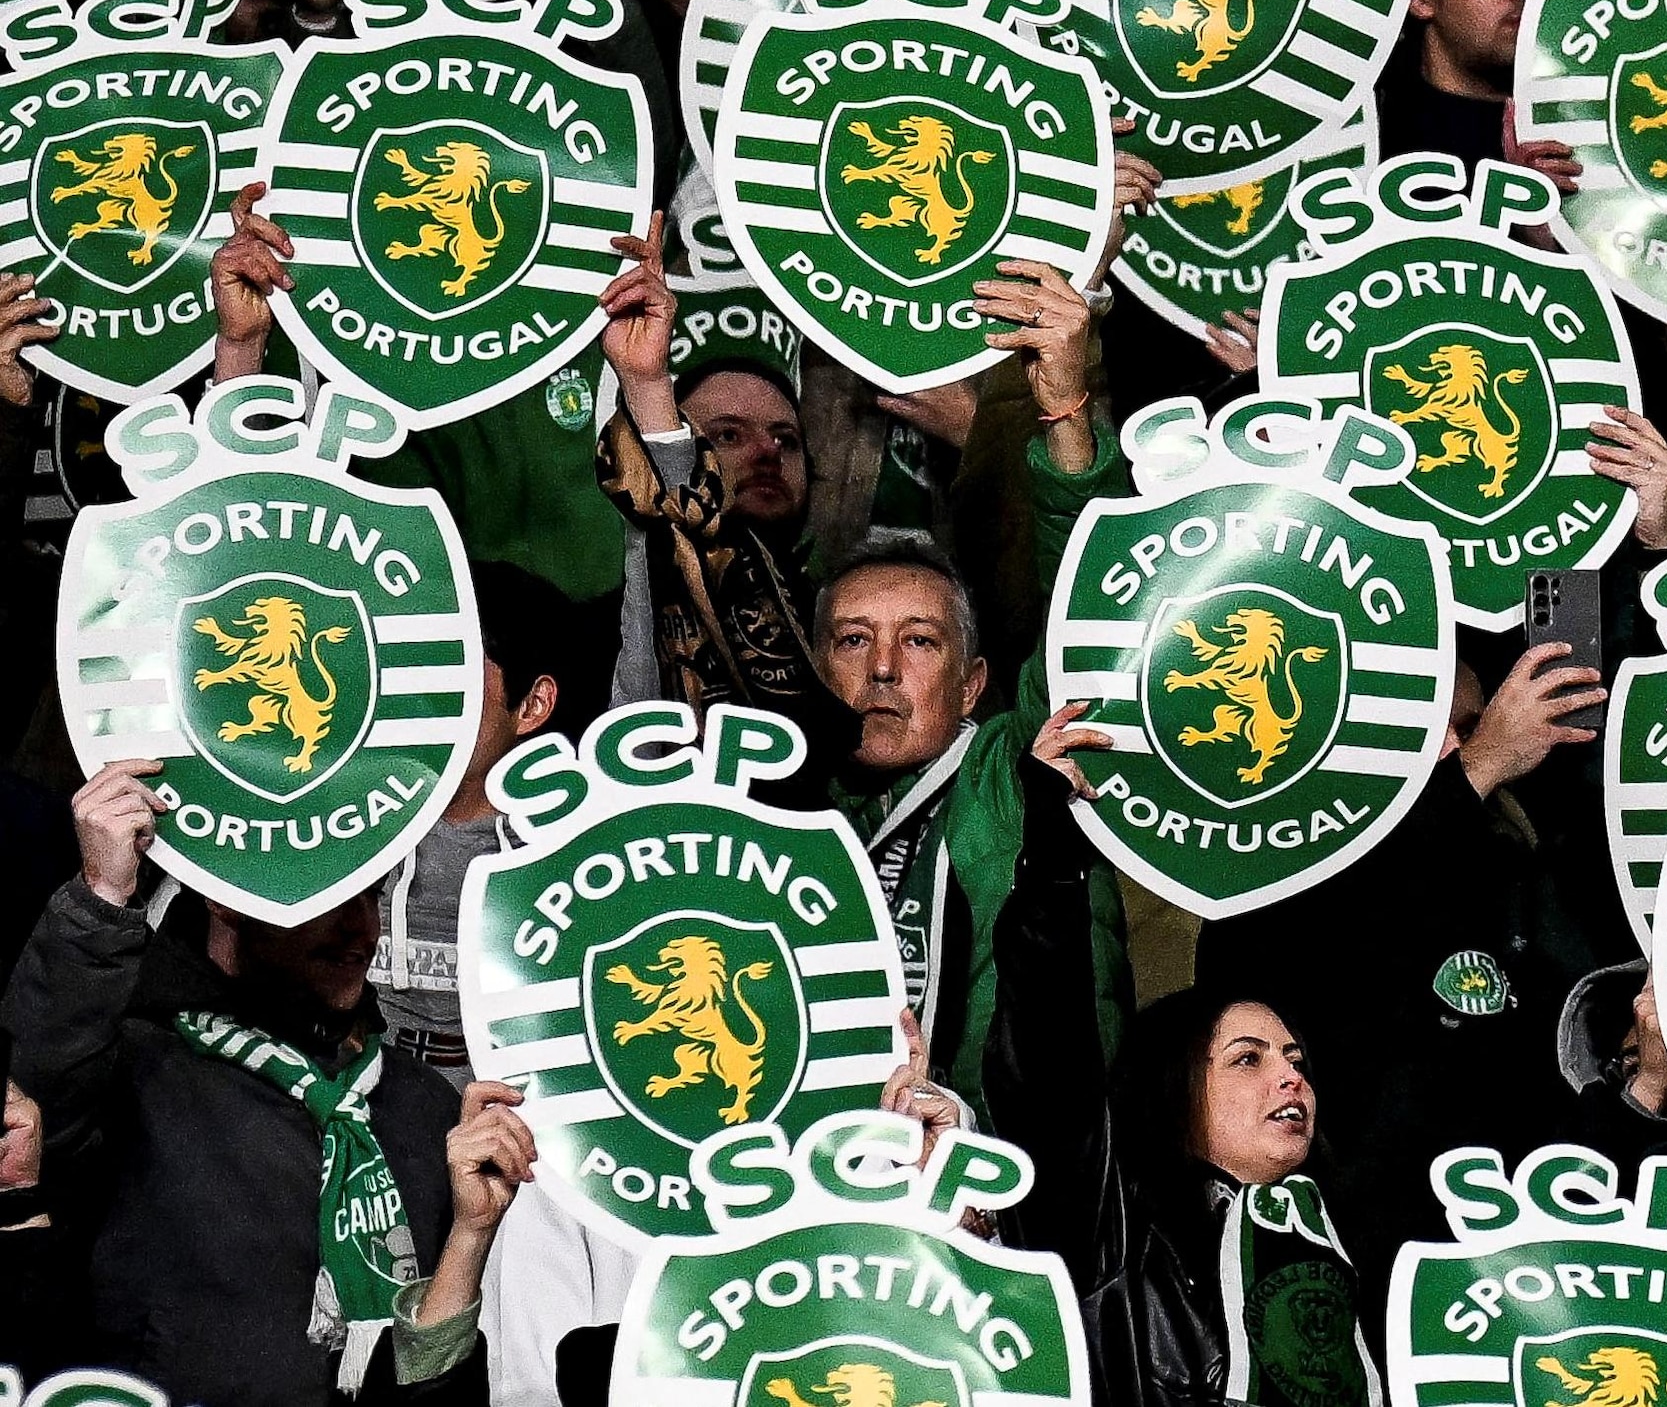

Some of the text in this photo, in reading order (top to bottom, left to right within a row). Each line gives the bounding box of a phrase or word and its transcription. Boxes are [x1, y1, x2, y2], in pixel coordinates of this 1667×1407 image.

[0, 62, 263, 157] SPORTING
[312, 54, 610, 168] SPORTING
[771, 33, 1070, 145] SPORTING
[1291, 158, 1552, 248] SCP
[303, 284, 571, 368] PORTUGAL
[1302, 257, 1587, 362] SPORTING
[113, 383, 401, 487] SCP
[1130, 400, 1415, 489] SCP
[1097, 508, 1409, 632] SPORTING
[147, 770, 426, 858] PORTUGAL
[493, 706, 797, 831] SCP
[1099, 773, 1372, 859] PORTUGAL
[510, 831, 841, 969] SPORTING
[700, 1120, 1027, 1223] SCP
[675, 1245, 1036, 1381] SPORTING
